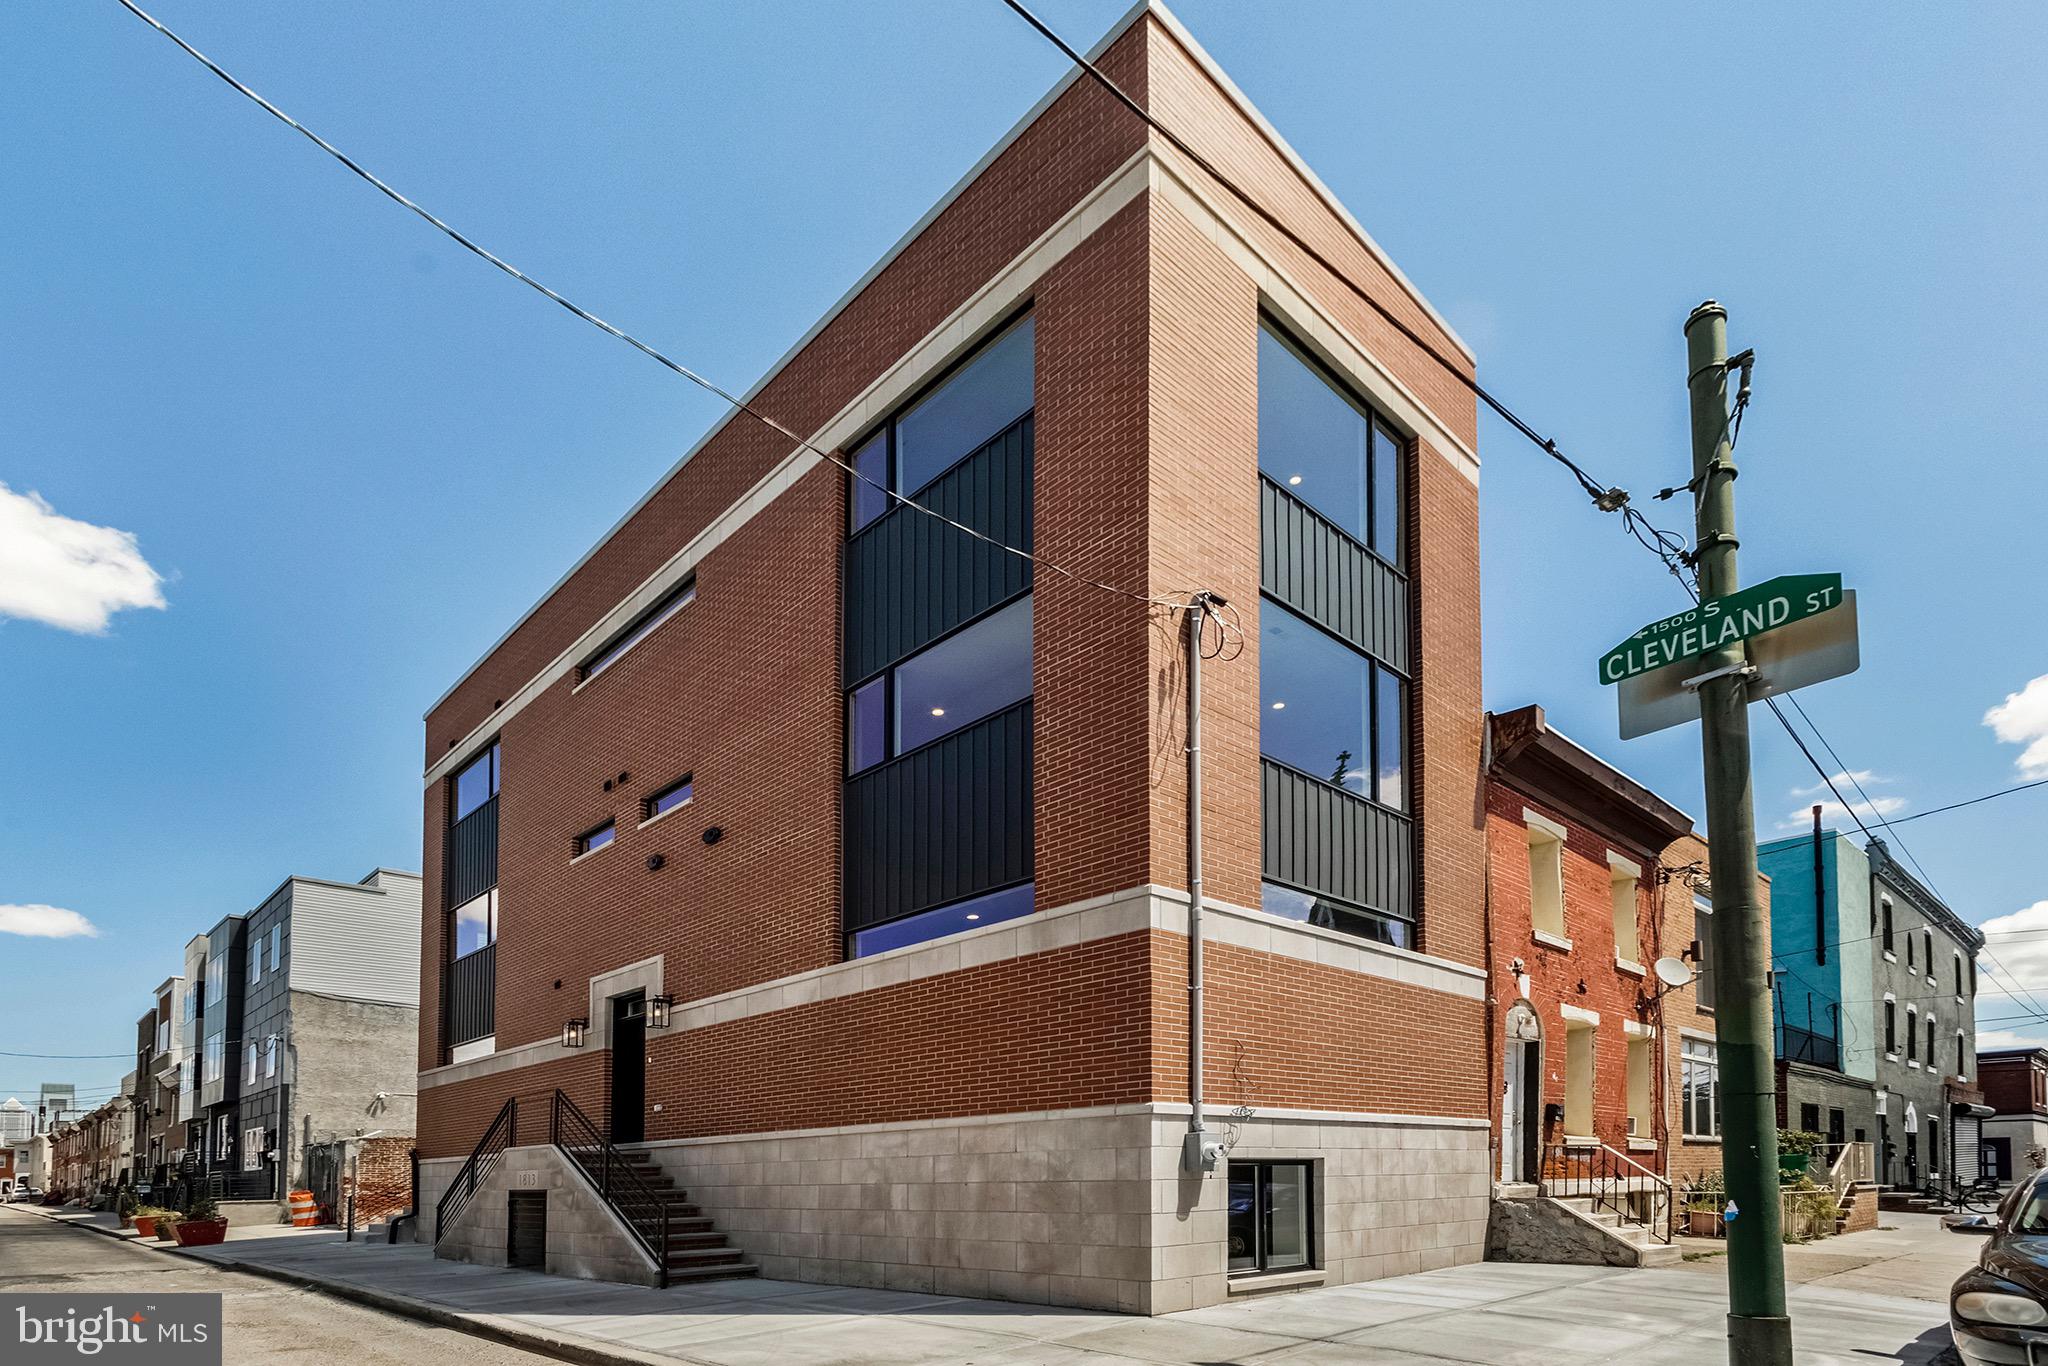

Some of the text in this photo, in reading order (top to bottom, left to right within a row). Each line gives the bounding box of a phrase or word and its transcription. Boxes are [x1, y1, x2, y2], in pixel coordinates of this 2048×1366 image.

[1606, 586, 1834, 680] CLEVELAND ST
[1651, 601, 1720, 634] 1500 S
[519, 1173, 536, 1186] 1813
